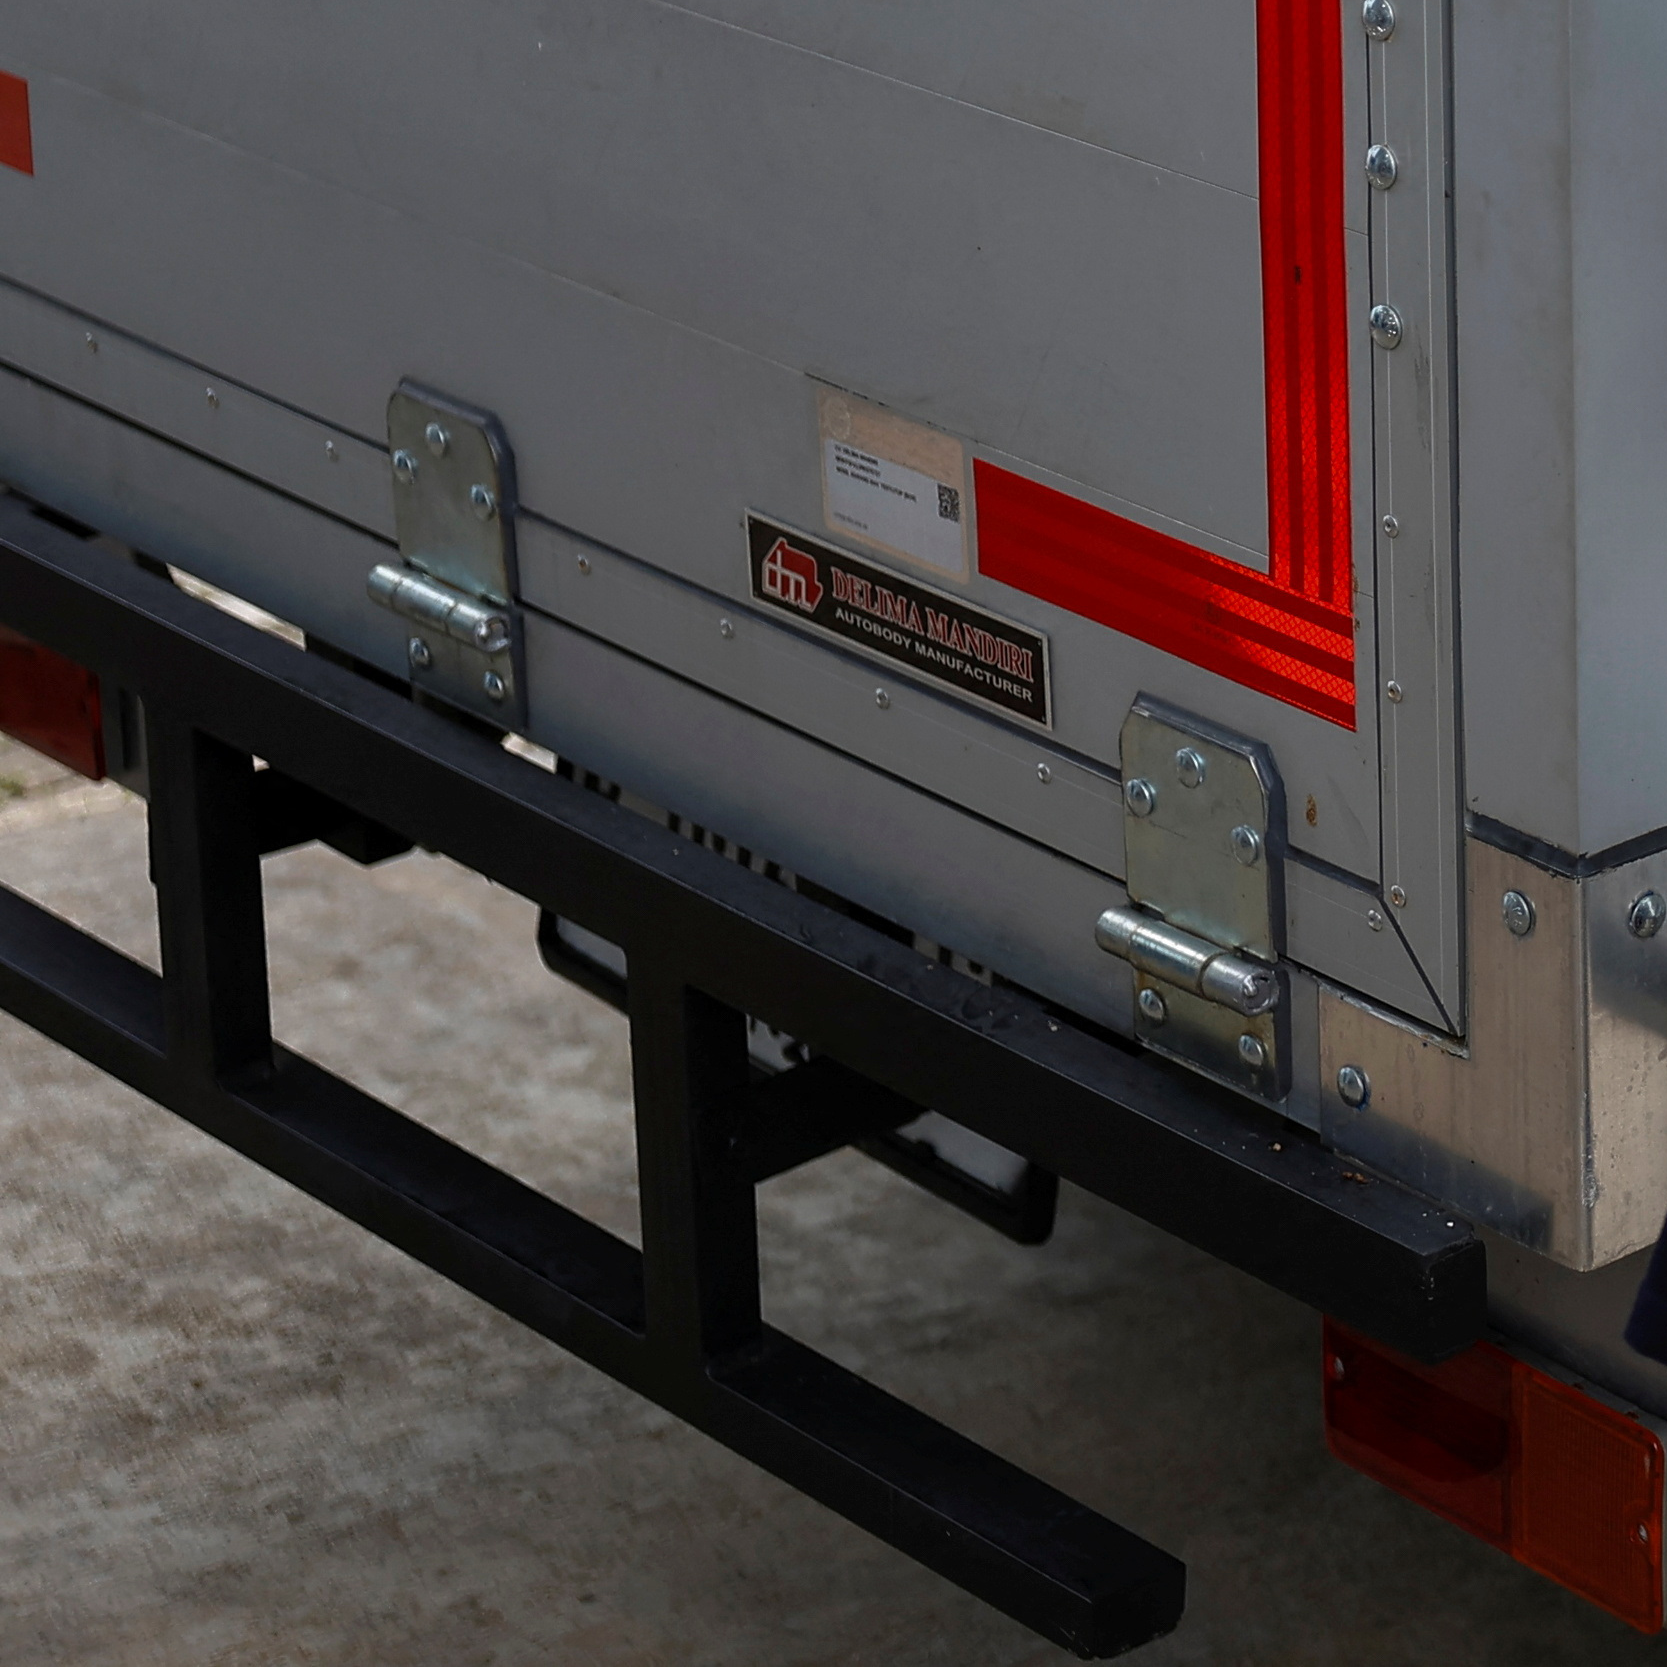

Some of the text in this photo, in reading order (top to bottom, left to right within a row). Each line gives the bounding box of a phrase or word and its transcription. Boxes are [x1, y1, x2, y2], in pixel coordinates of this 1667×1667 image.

[831, 566, 1033, 683] DELIMA MANDIRI
[835, 606, 1033, 703] AUTOBODY MANUFACTURER
